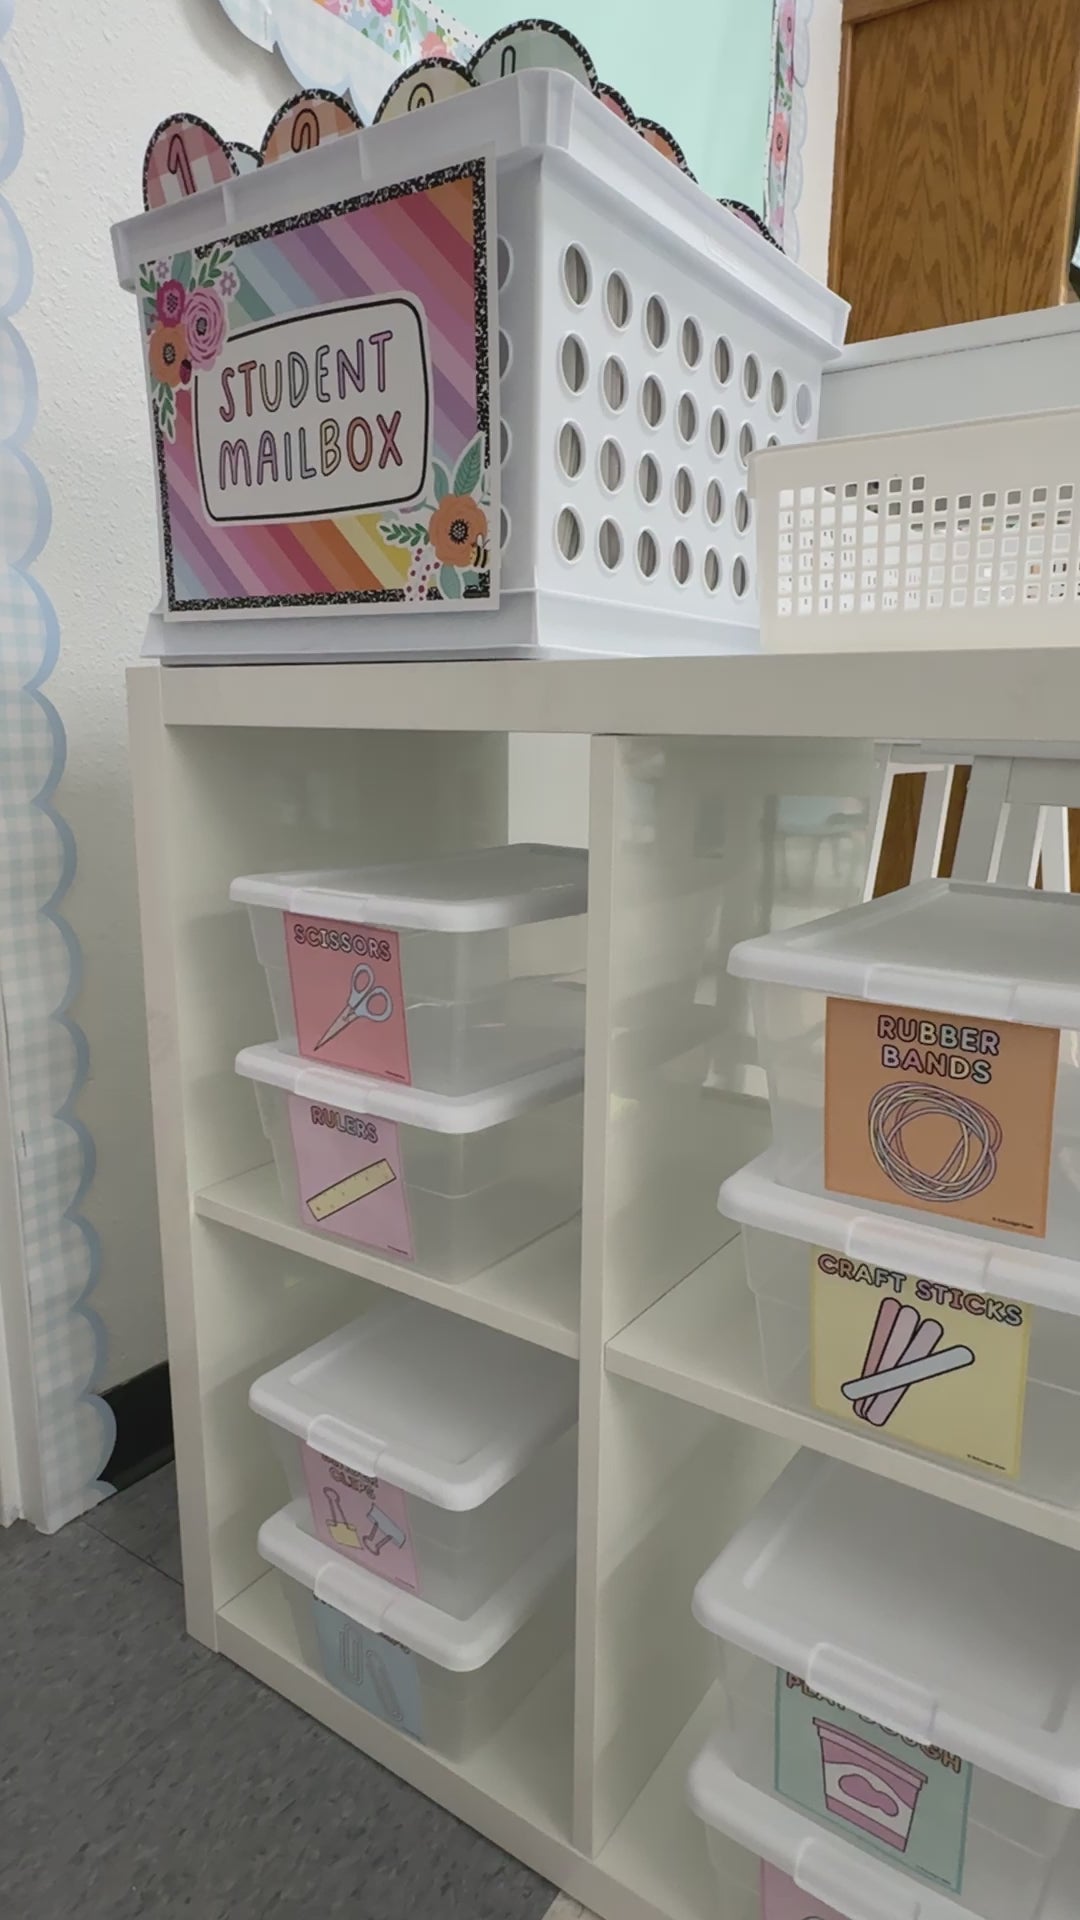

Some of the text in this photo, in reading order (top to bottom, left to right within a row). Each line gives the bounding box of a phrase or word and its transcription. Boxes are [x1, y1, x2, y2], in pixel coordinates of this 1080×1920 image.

[219, 330, 393, 423] STUDENT
[219, 410, 403, 491] MAILBOX
[293, 924, 392, 962] SCISSORS
[877, 1014, 1001, 1056] RUBBER
[881, 1044, 992, 1084] BANDS
[310, 1105, 379, 1144] RULERS
[817, 1253, 1023, 1327] CRAFT STICKS
